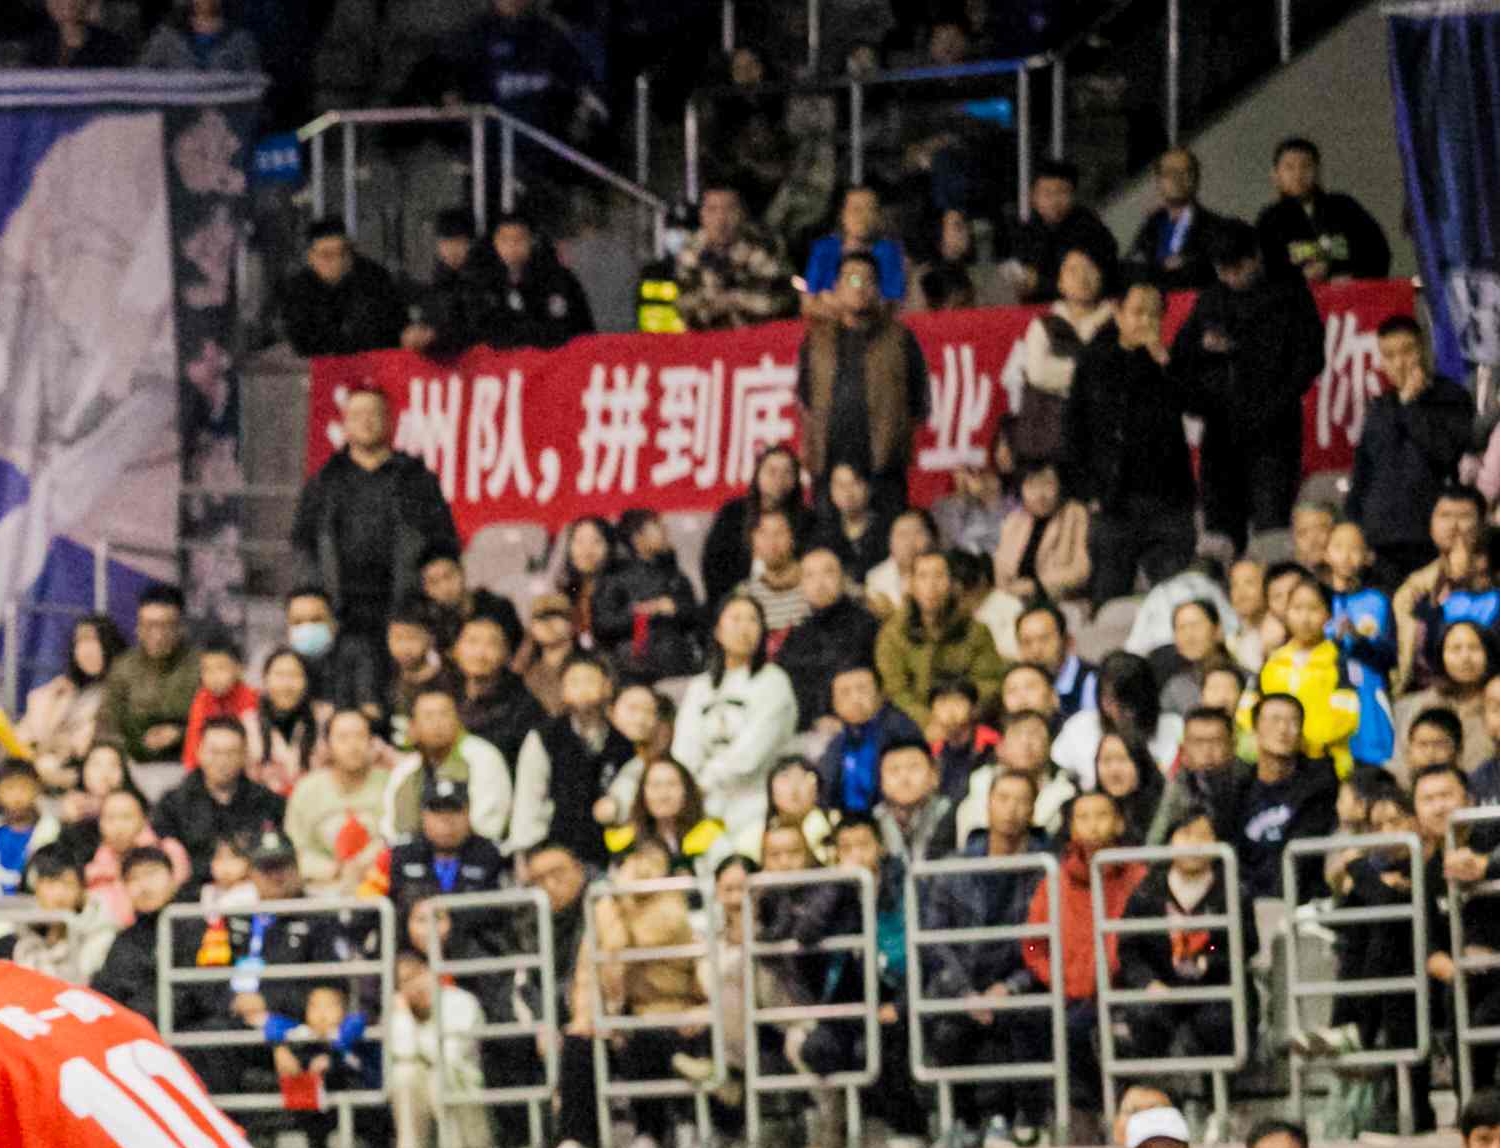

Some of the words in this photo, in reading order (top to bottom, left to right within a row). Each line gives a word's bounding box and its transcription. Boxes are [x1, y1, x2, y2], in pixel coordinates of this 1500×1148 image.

[326, 354, 799, 502] 州队，拼到底
